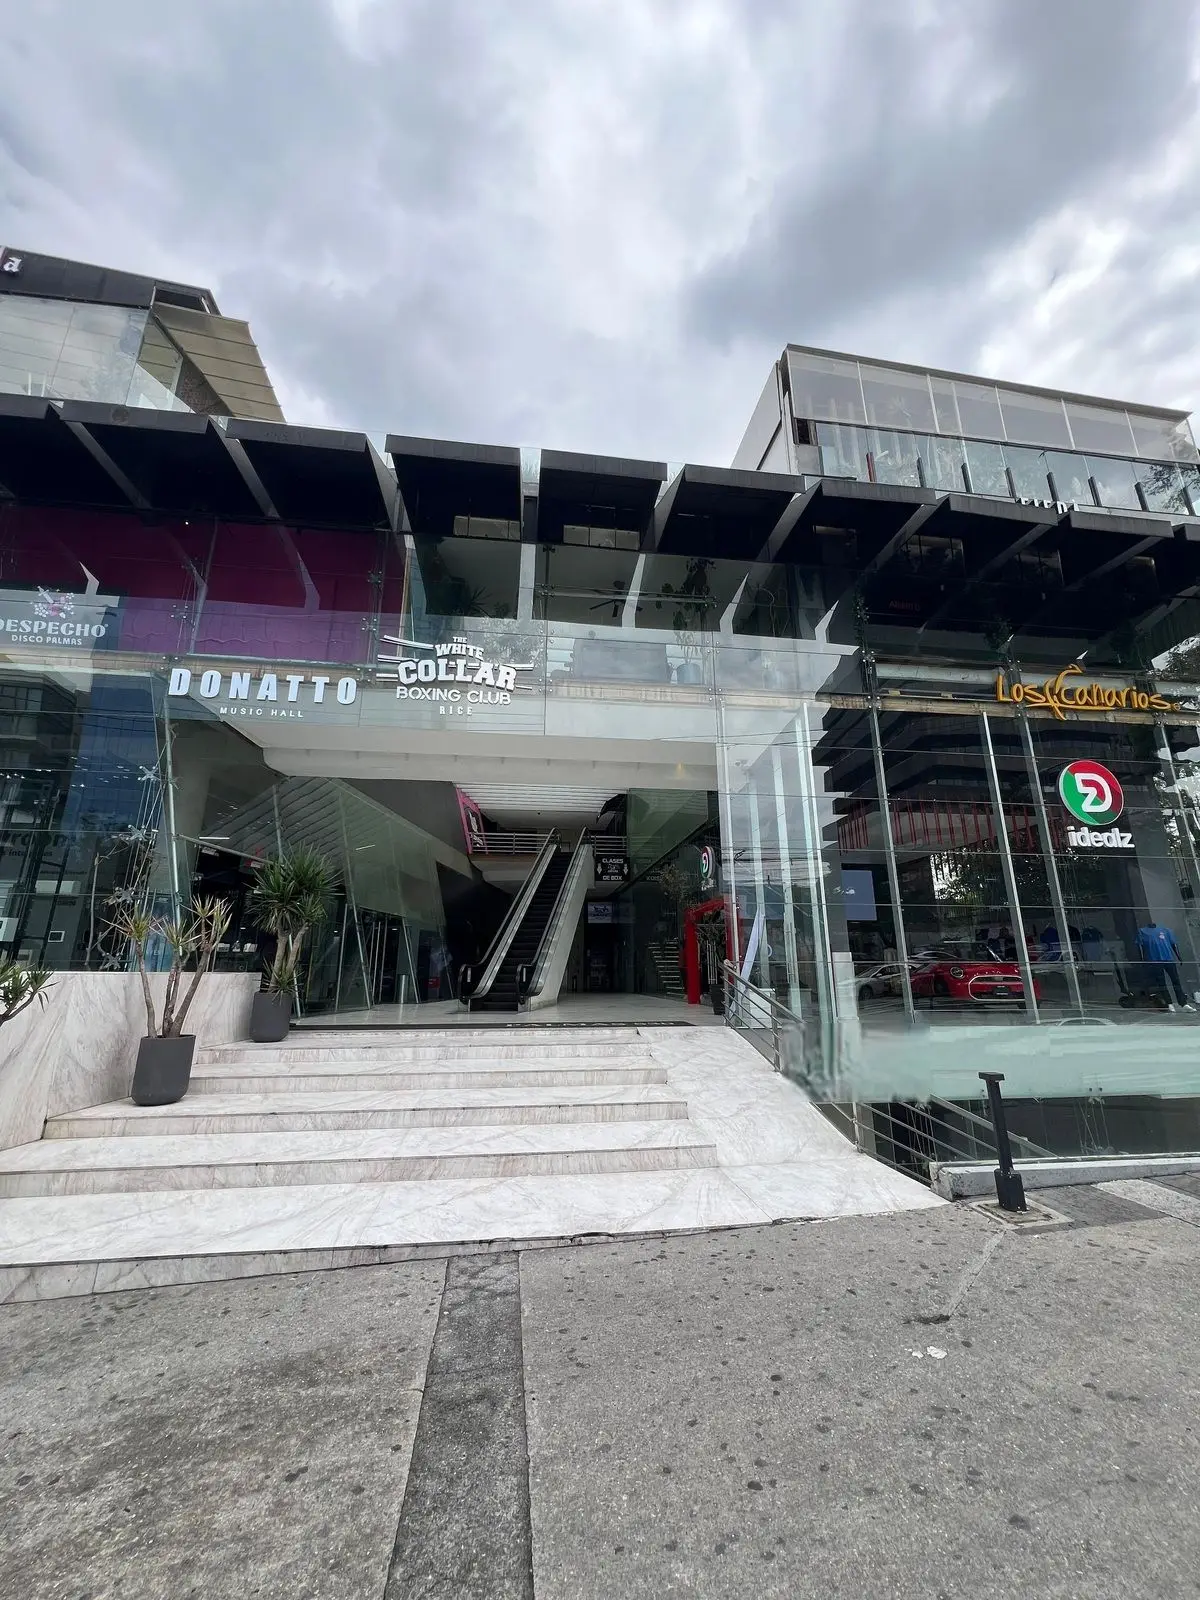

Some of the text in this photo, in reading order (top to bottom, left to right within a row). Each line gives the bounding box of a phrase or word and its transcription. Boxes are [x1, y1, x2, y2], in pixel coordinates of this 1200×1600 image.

[12, 634, 82, 645] DISCO PALMAS
[453, 636, 467, 644] THE
[435, 644, 484, 661] WHITE
[398, 658, 517, 692] COLLAR
[168, 668, 357, 705] DONATTO
[396, 686, 511, 705] BOXING CLUB
[996, 675, 1046, 703] Los
[219, 707, 304, 718] MUSIC HALL
[440, 705, 473, 716] RICE
[1066, 826, 1135, 848] idealz
